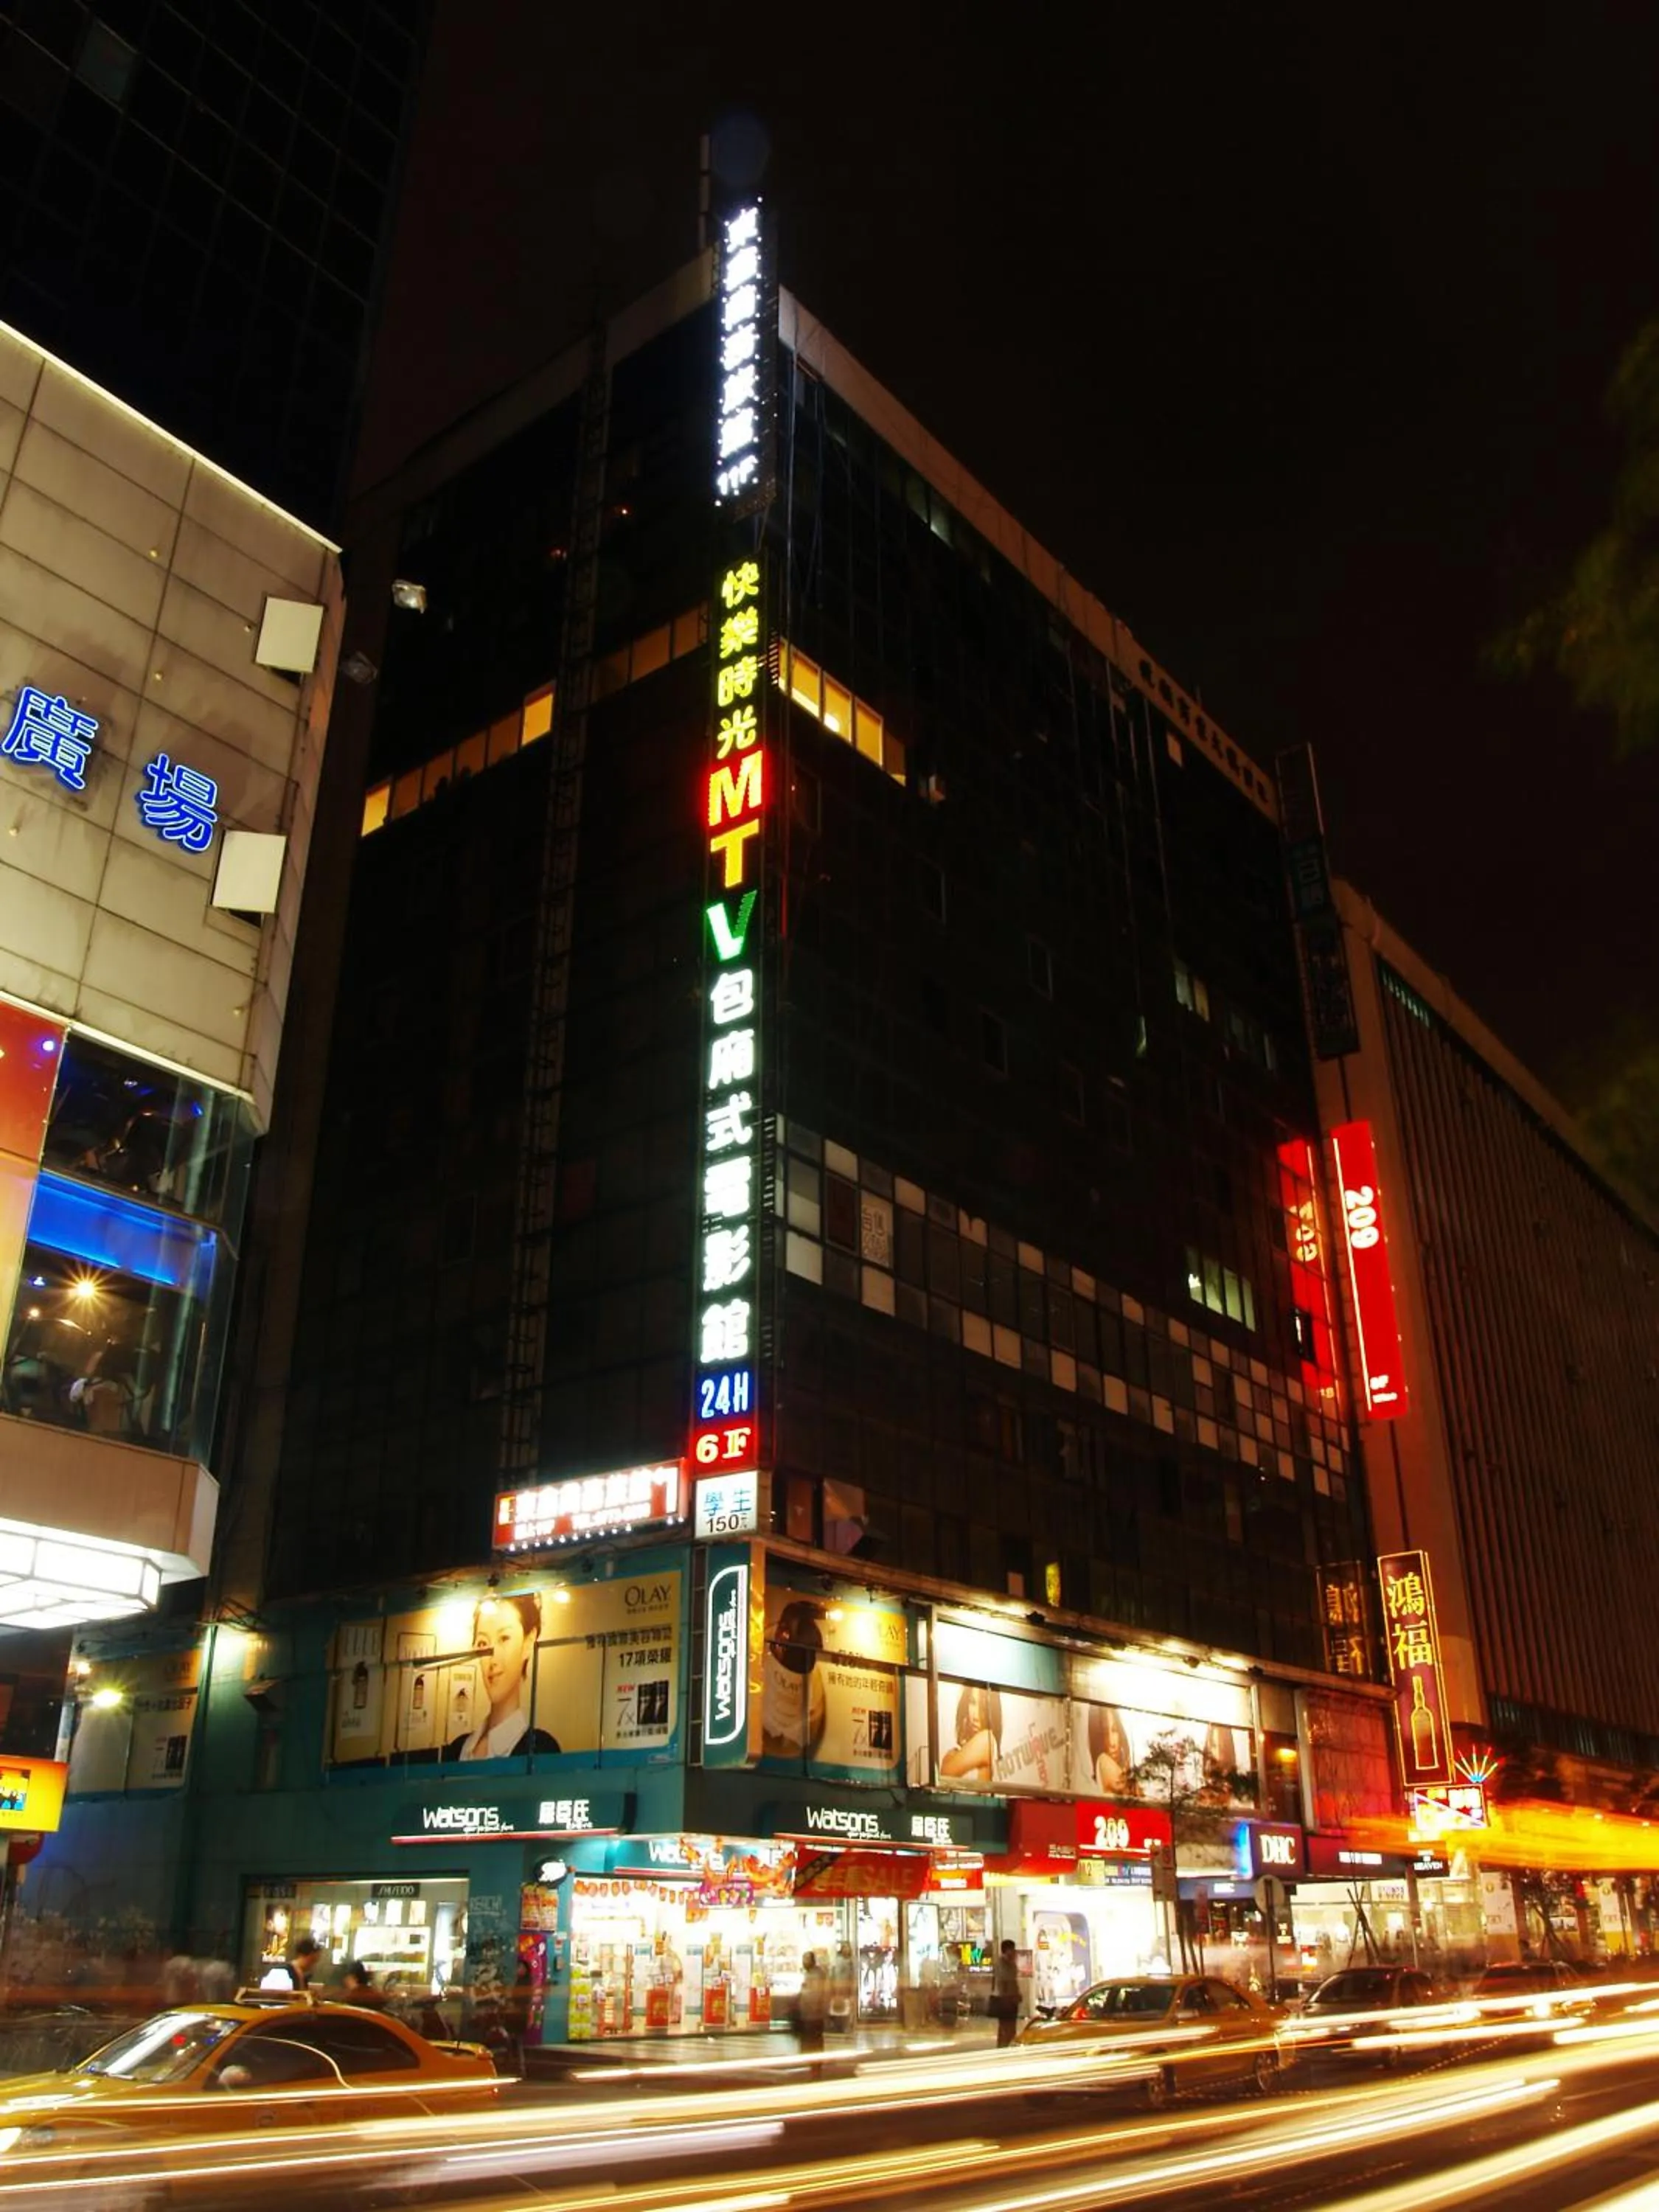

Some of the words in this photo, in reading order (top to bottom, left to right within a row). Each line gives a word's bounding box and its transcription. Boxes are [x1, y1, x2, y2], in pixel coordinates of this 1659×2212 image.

[716, 562, 759, 759] 快樂時光
[1, 686, 220, 854] 廣場
[706, 749, 762, 961] MTV
[1345, 1185, 1380, 1250] 209
[700, 1371, 749, 1419] 24H
[695, 1427, 751, 1464] 6F
[703, 1488, 751, 1517] 學生
[625, 1585, 672, 1607] OLAY
[1387, 1573, 1433, 1669] 鴻福
[423, 1806, 499, 1829] Watsons
[807, 1806, 879, 1832] Watsons
[1094, 1815, 1130, 1848] 209
[1261, 1834, 1296, 1865] DHC
